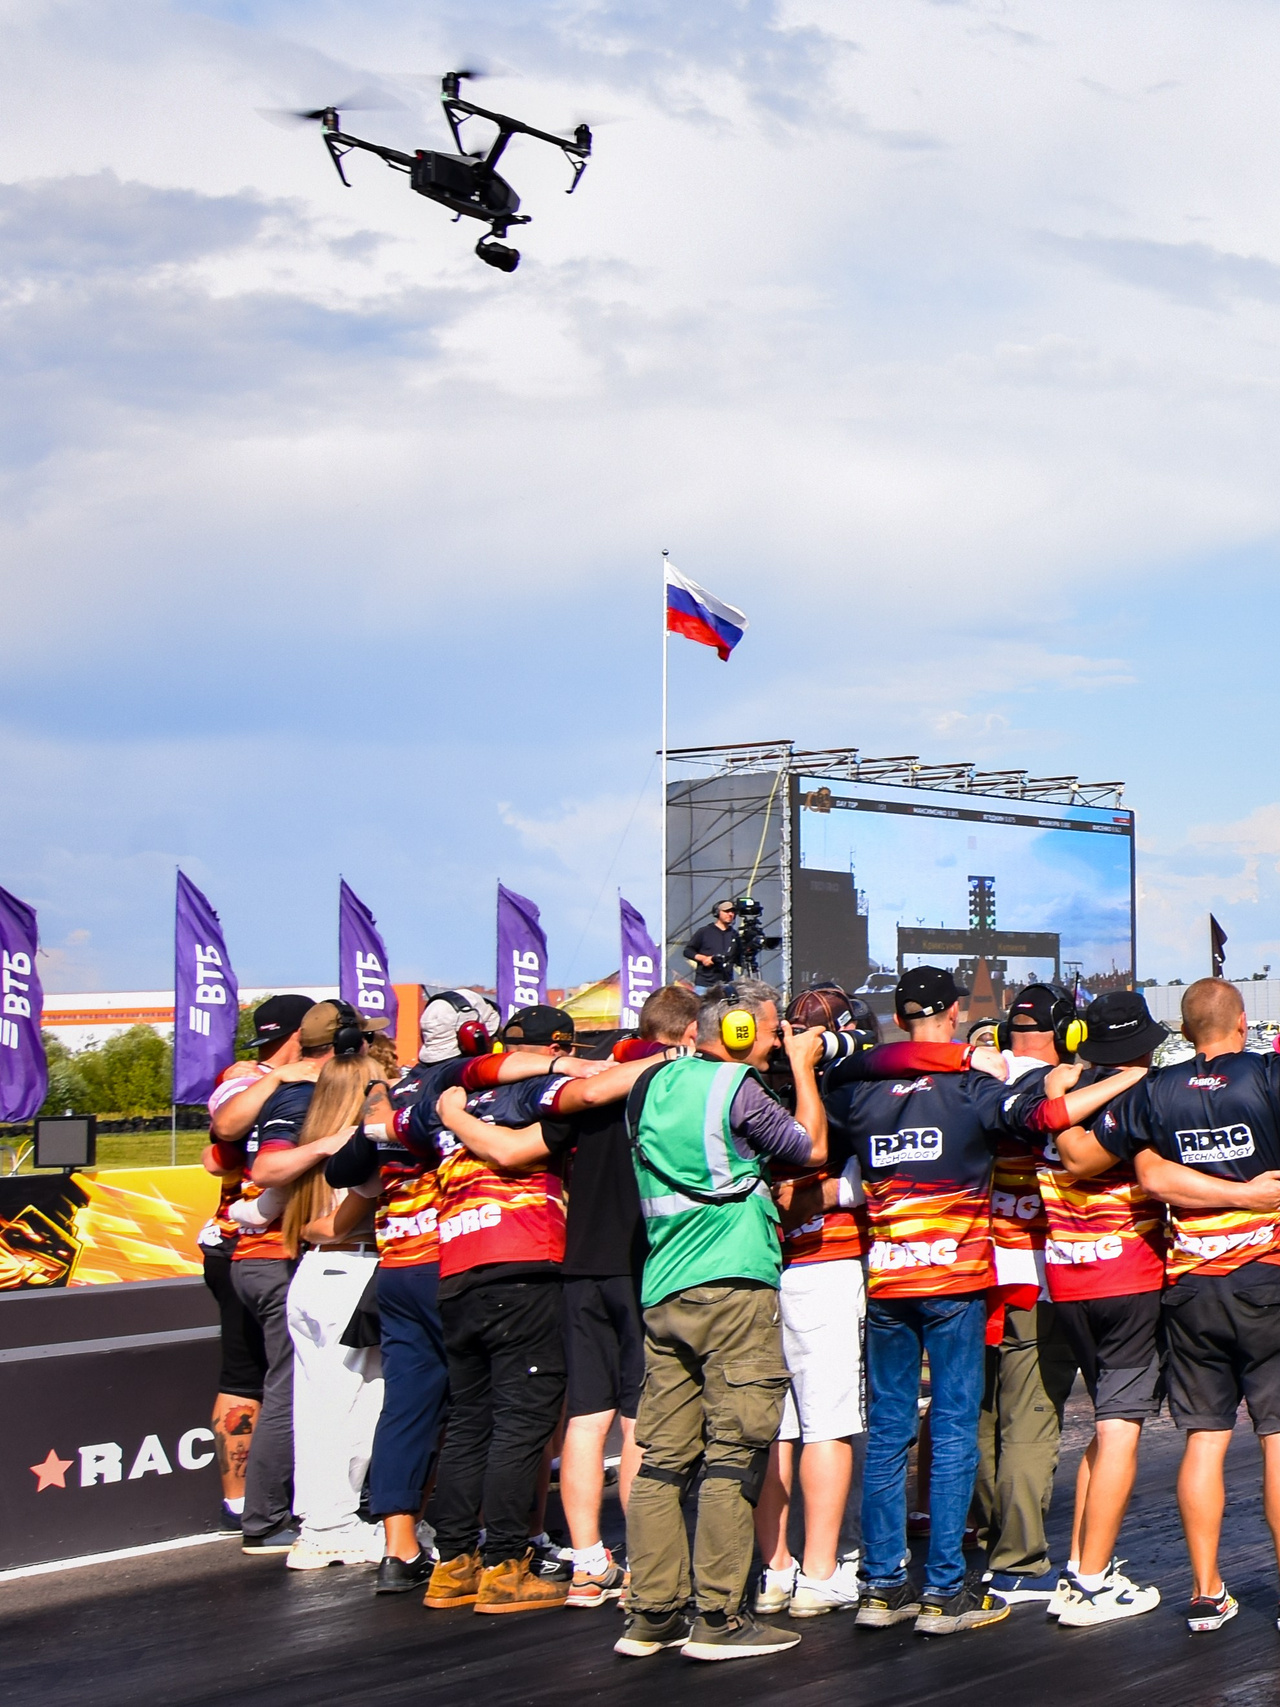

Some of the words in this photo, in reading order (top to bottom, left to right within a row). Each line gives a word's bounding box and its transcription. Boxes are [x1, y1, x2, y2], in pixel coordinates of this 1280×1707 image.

[3, 949, 31, 1018] ВТБ
[195, 943, 226, 1004] ВТБ
[356, 950, 385, 1010] ВТБ
[513, 950, 540, 1006] ВТБ
[628, 955, 653, 1008] ВТБ
[1178, 1125, 1249, 1152] RDRC
[1182, 1146, 1251, 1162] TECHNOLOGY
[992, 1190, 1041, 1220] RC
[79, 1427, 215, 1487] RAC
